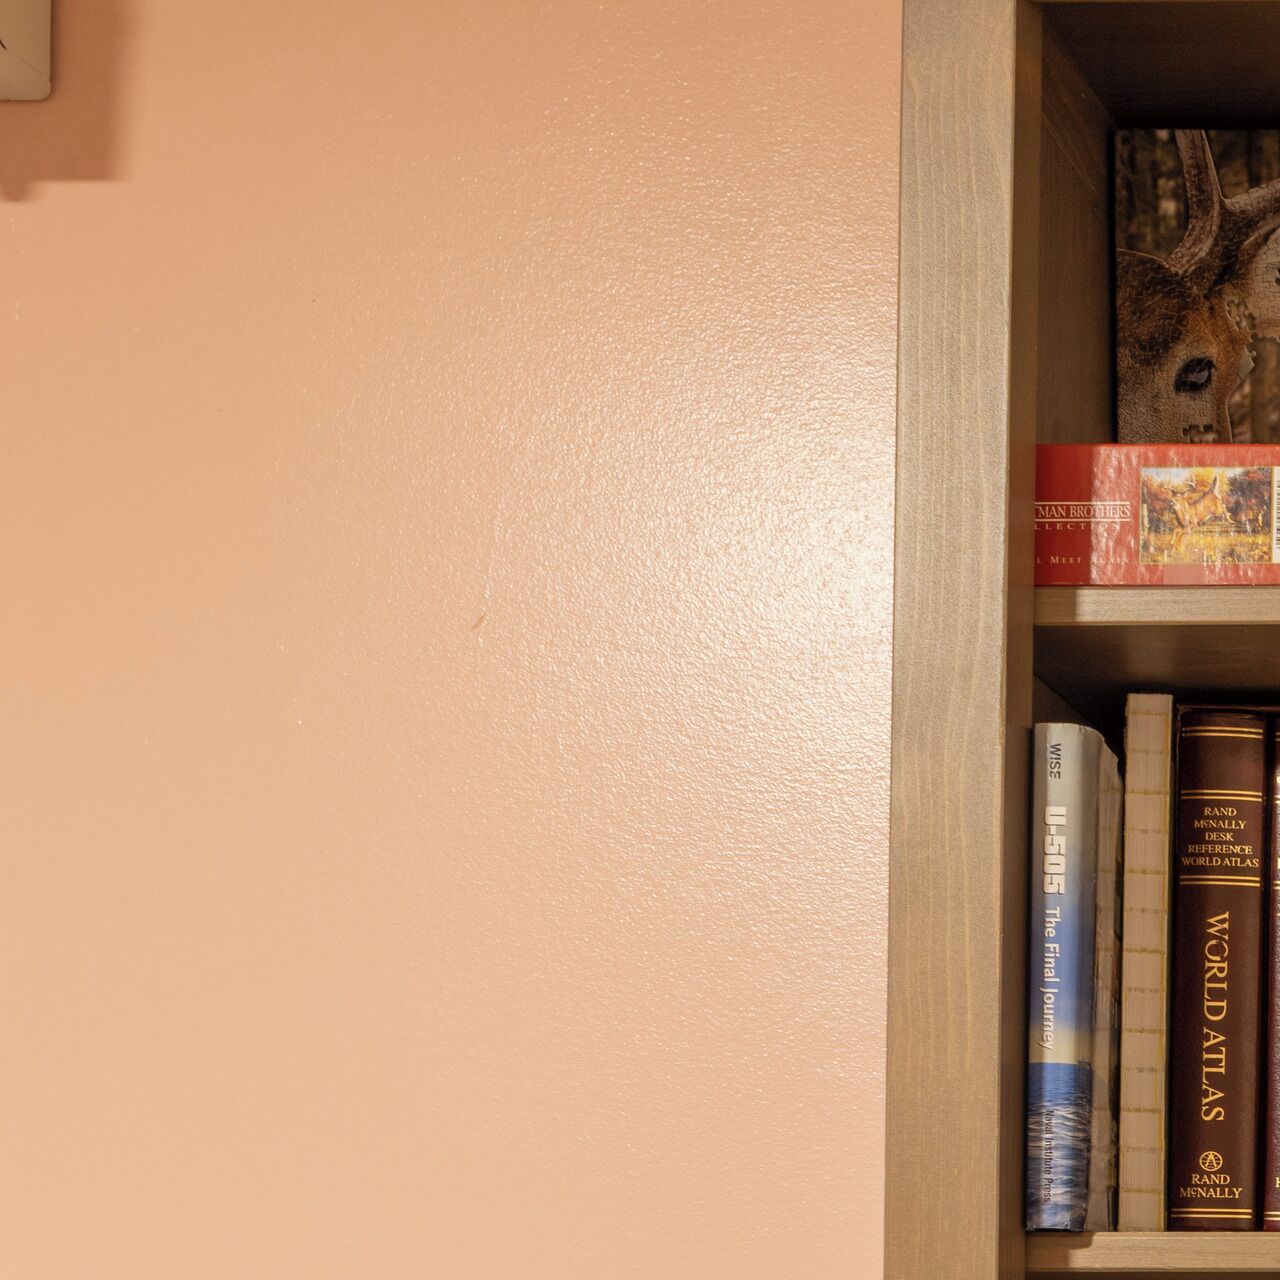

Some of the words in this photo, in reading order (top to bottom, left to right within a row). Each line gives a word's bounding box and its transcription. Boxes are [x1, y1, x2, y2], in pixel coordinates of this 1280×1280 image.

[1070, 505, 1131, 518] BROTHERS
[1050, 742, 1062, 780] WISE
[1204, 807, 1237, 816] RAND
[1043, 806, 1066, 895] U-505
[1188, 845, 1252, 855] REFERENCE
[1205, 832, 1234, 841] DESK
[1182, 857, 1221, 867] WORLD
[1223, 858, 1260, 868] ATLAS
[1044, 906, 1061, 937] The
[1044, 943, 1060, 982] Final
[1203, 911, 1229, 1021] WORLD
[1038, 988, 1054, 1050] Journey
[1201, 1027, 1226, 1121] ATLAS
